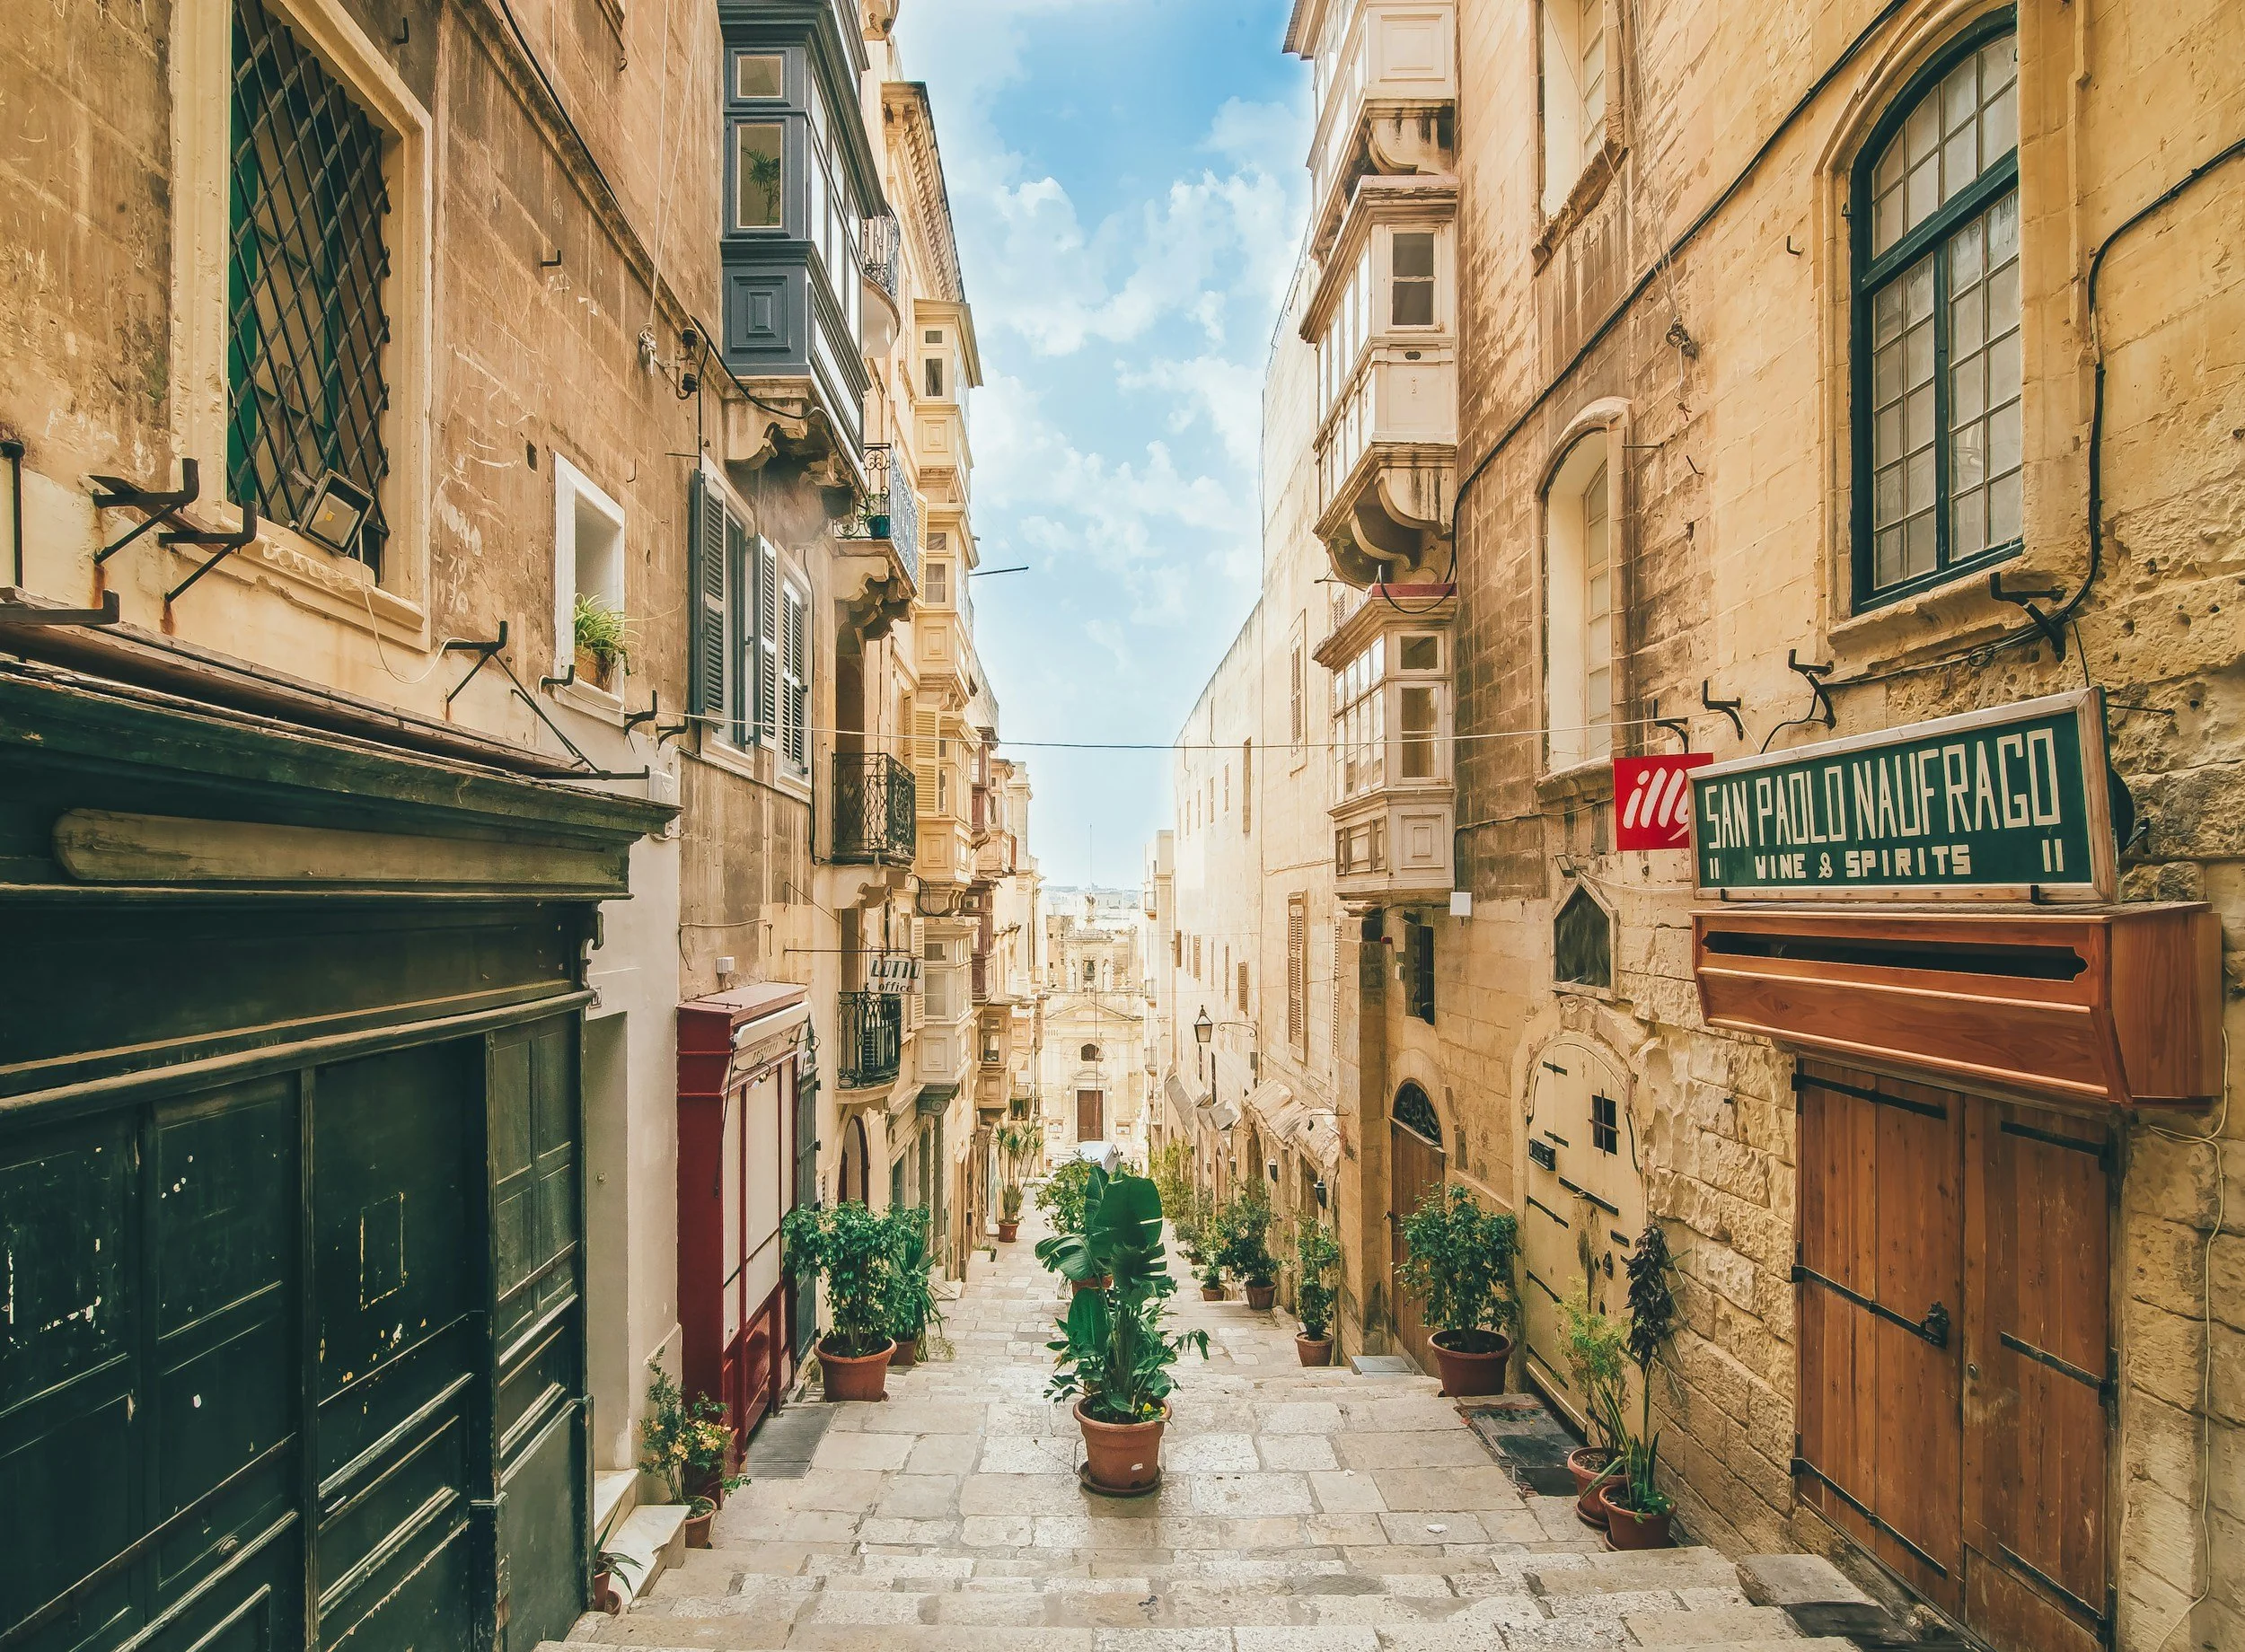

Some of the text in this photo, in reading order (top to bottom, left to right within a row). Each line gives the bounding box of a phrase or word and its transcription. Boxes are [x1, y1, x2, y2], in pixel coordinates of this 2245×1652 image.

[1704, 727, 2062, 849] SAN PAOLO NAUFRAGO
[1755, 852, 1807, 880] WINE
[1818, 852, 1834, 879] &
[1844, 844, 1972, 878] SPIRITS
